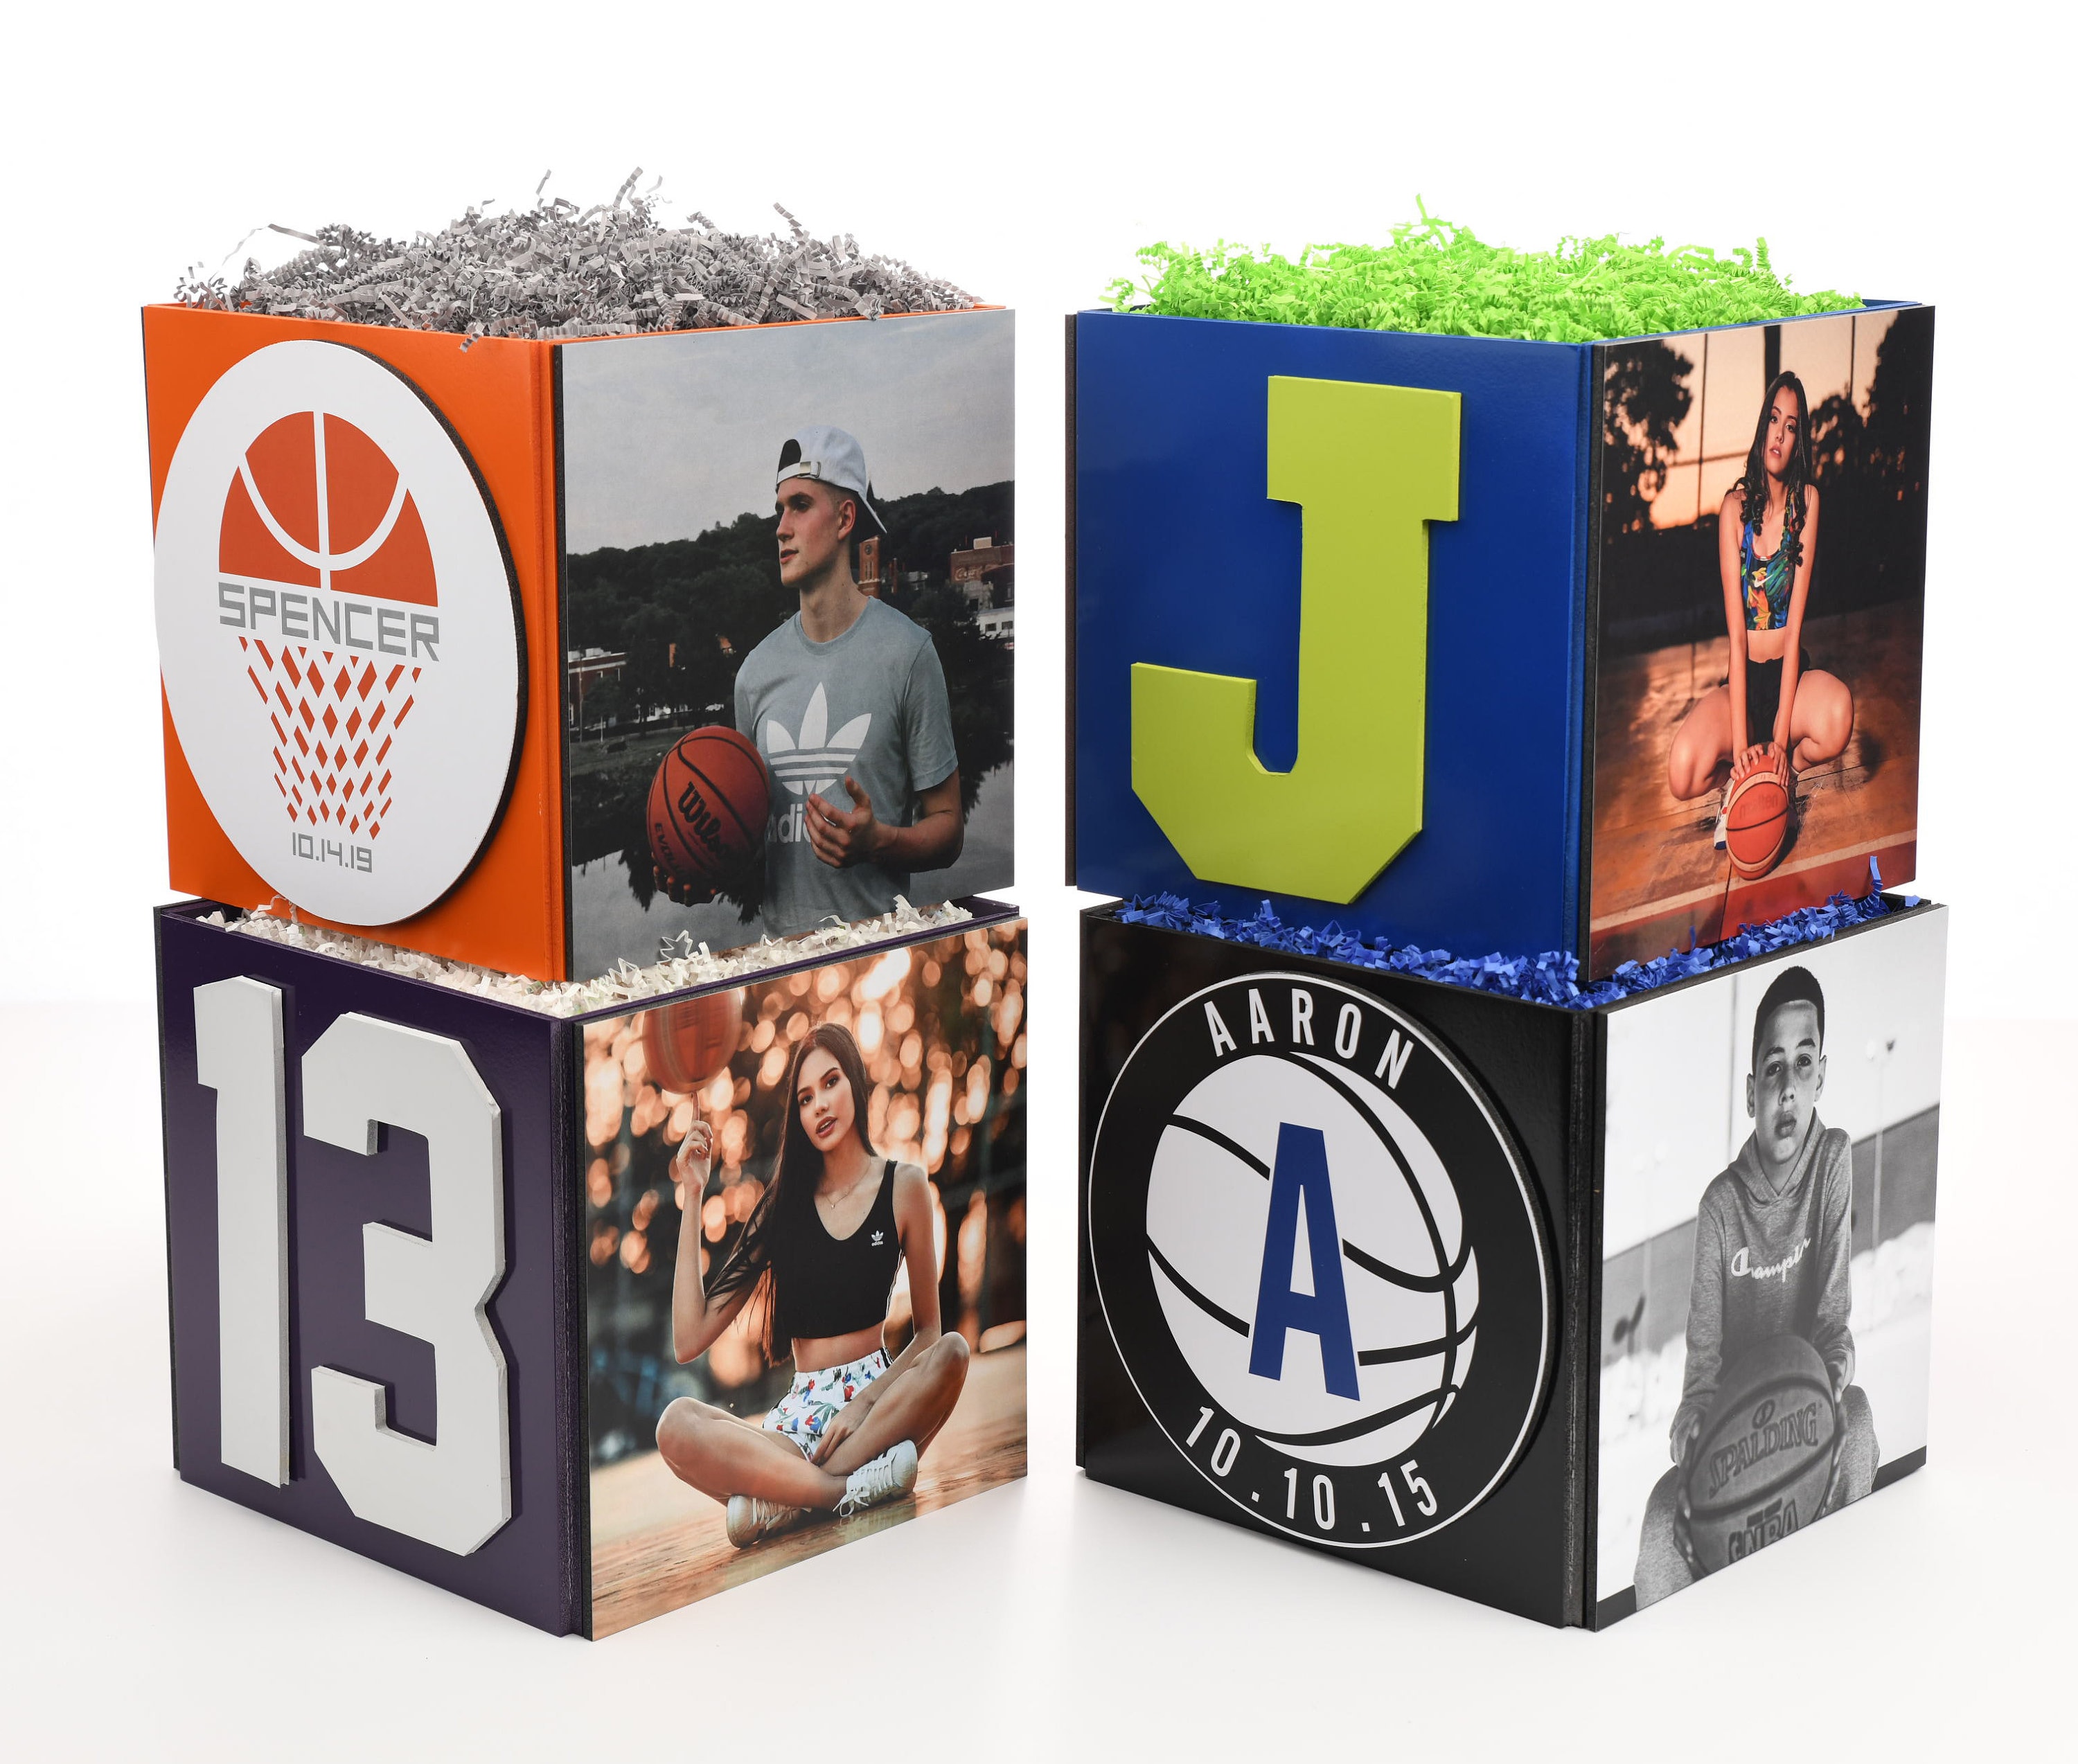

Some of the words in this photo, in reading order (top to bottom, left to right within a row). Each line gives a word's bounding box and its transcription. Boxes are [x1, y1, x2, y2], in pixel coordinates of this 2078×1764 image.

[218, 582, 439, 661] SPENCER
[1131, 375, 1462, 905] J
[292, 832, 372, 873] 10.14.19
[678, 781, 726, 857] Wils
[1204, 988, 1413, 1089] AARON
[193, 975, 511, 1556] 13
[1248, 1122, 1360, 1401] A
[1731, 1238, 1811, 1283] Champin
[1709, 1402, 1818, 1499] SPALDING
